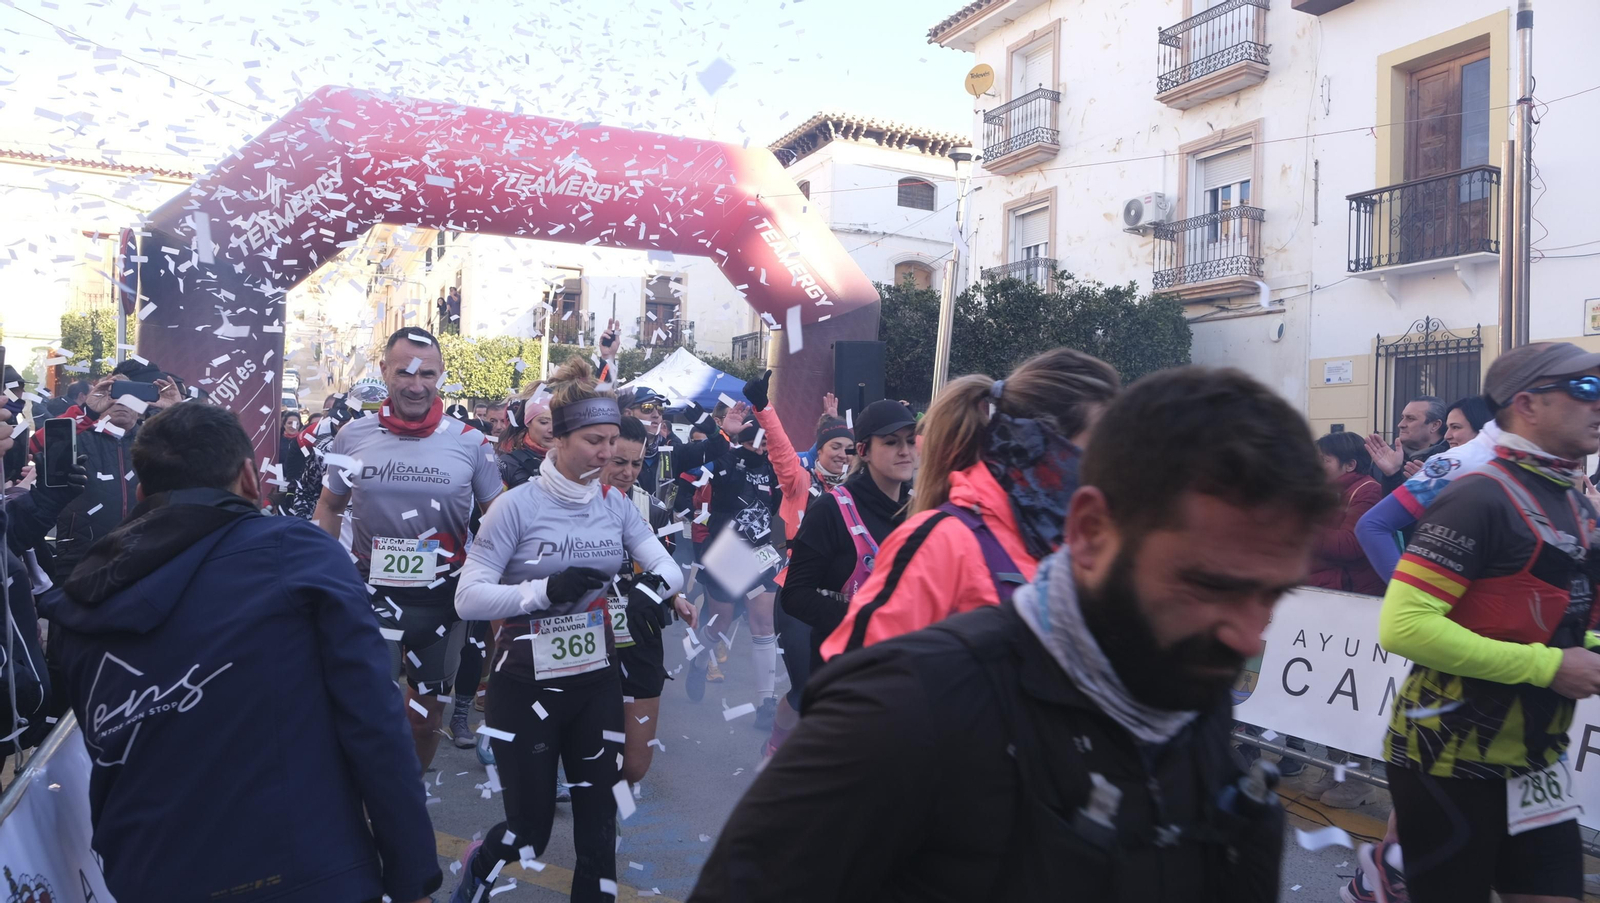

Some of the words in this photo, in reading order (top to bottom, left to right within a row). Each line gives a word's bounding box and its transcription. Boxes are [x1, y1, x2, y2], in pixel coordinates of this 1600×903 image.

[505, 171, 629, 202] TEAMERGY
[754, 217, 834, 306] TEAMERGY
[396, 466, 440, 475] CALAR
[411, 476, 451, 485] MUNDO
[575, 539, 614, 549] CALAR
[573, 551, 590, 559] RIO
[592, 548, 622, 558] MUNDO
[383, 554, 423, 573] 202
[542, 617, 551, 626] IV
[553, 615, 573, 626] CxM
[551, 632, 596, 661] 368
[148, 701, 178, 715] STOP
[1518, 770, 1563, 808] 286
